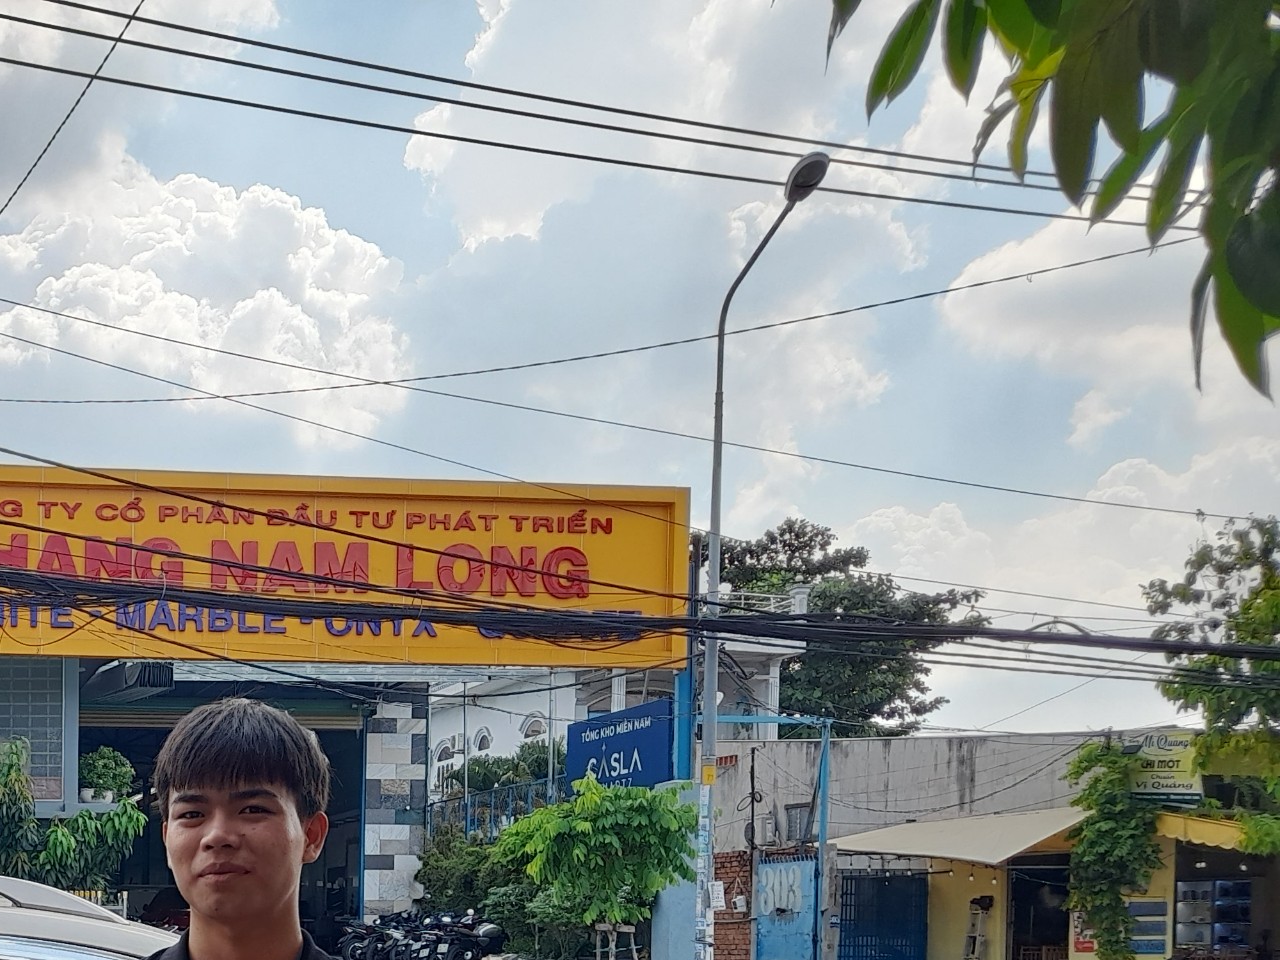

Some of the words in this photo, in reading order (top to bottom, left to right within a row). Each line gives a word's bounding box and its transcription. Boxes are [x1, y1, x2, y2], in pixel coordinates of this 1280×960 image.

[37, 501, 82, 519] TY
[95, 497, 146, 522] CỔ
[349, 508, 398, 529] TƯ
[406, 510, 499, 531] PHÁT
[509, 509, 613, 534] TRIỂN
[210, 539, 370, 594] NAM
[396, 543, 590, 600] LONG
[116, 598, 287, 634] MARBLE
[581, 727, 600, 743] TỔNG
[600, 723, 615, 739] KHO
[634, 715, 651, 730] NAM
